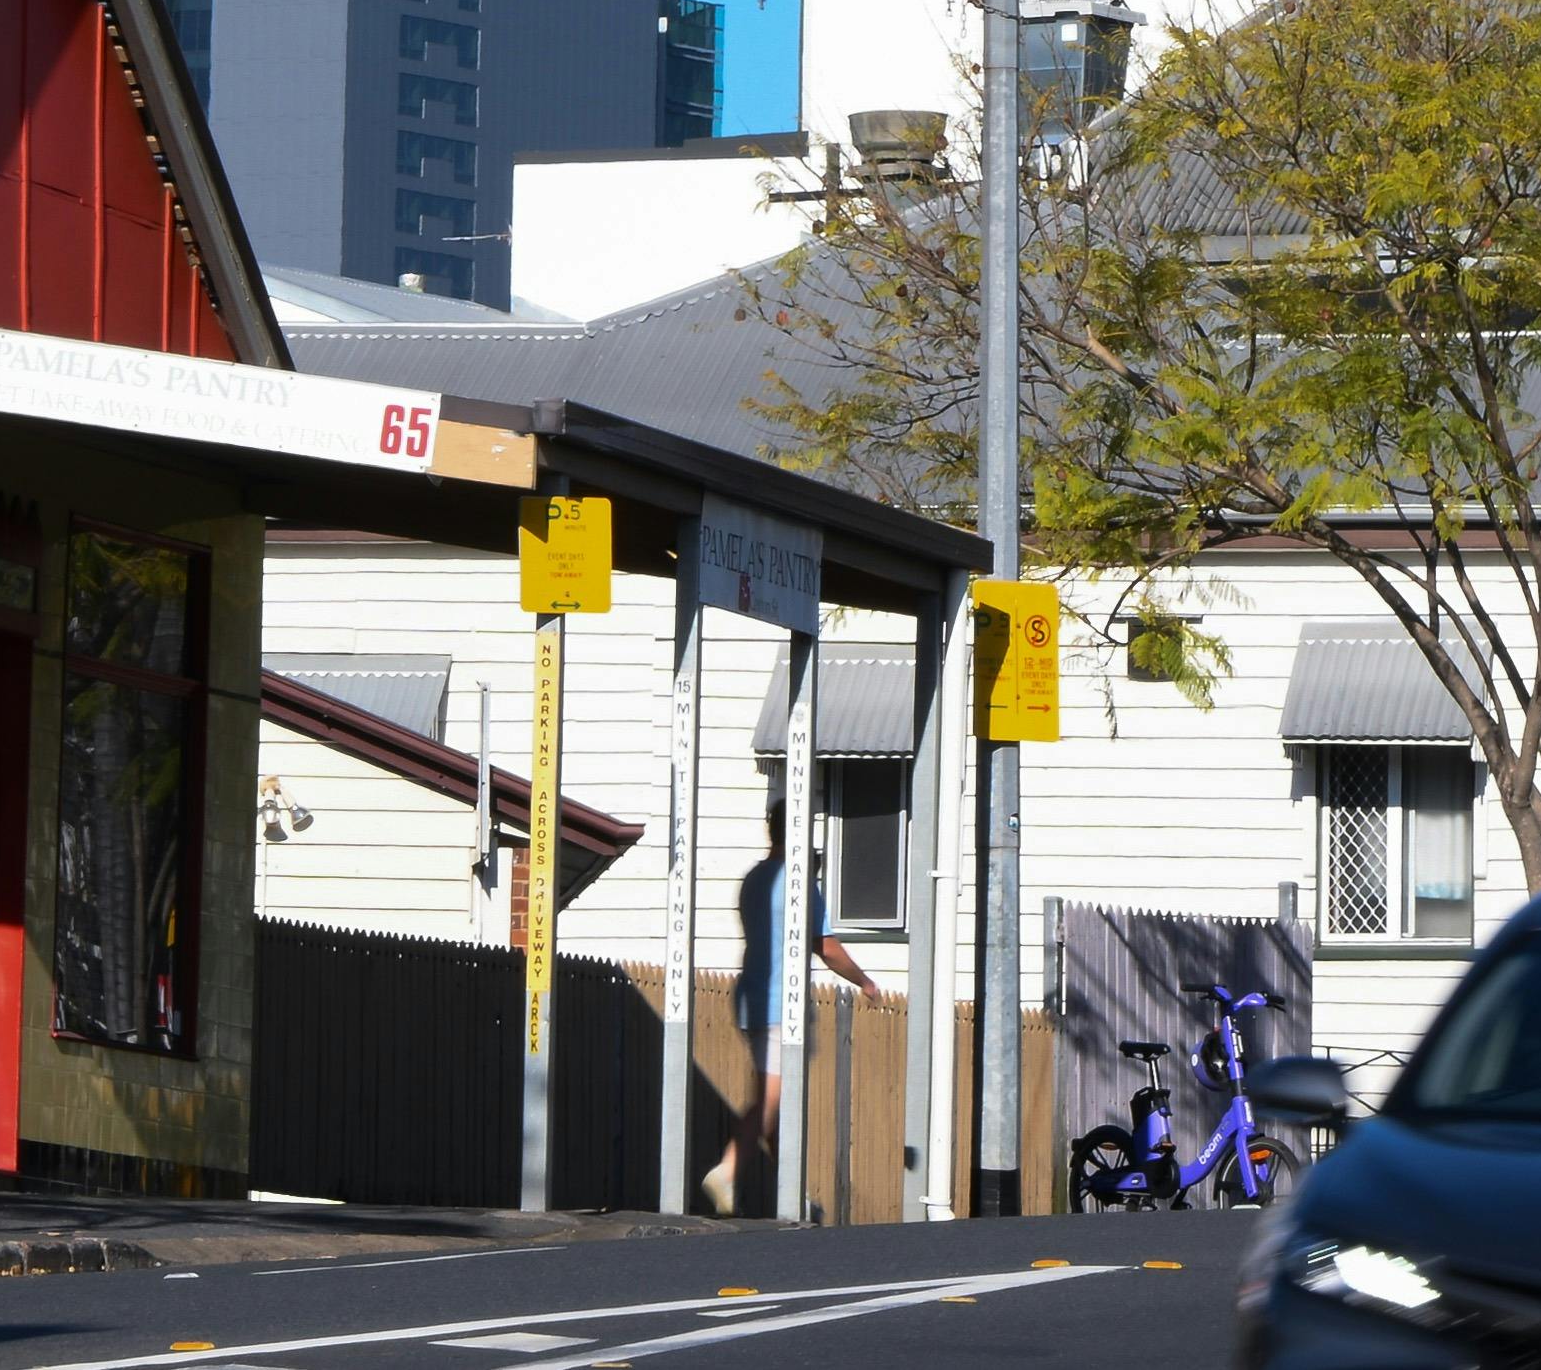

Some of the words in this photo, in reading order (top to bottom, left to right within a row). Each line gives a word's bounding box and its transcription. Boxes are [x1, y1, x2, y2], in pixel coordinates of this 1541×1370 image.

[163, 364, 298, 409] PANTRY
[162, 405, 225, 434] FOOD
[254, 421, 370, 457] CATERING
[378, 403, 433, 459] 65
[701, 524, 765, 581] PAMELA'S
[769, 545, 819, 596] PANTRY
[541, 645, 551, 668] NO
[677, 680, 691, 694] 15
[539, 679, 551, 767] PARKING
[675, 703, 690, 802] MINT
[792, 732, 806, 827] MINUTE
[537, 791, 548, 866] ACROSS
[674, 818, 687, 932] PARKING
[789, 846, 802, 959] PARKING
[533, 877, 545, 978] DRIVEWAY
[672, 950, 683, 1013] ONLY
[788, 975, 799, 1037] ONLY
[531, 993, 539, 1052] ARCK
[1199, 1133, 1223, 1165] beam
